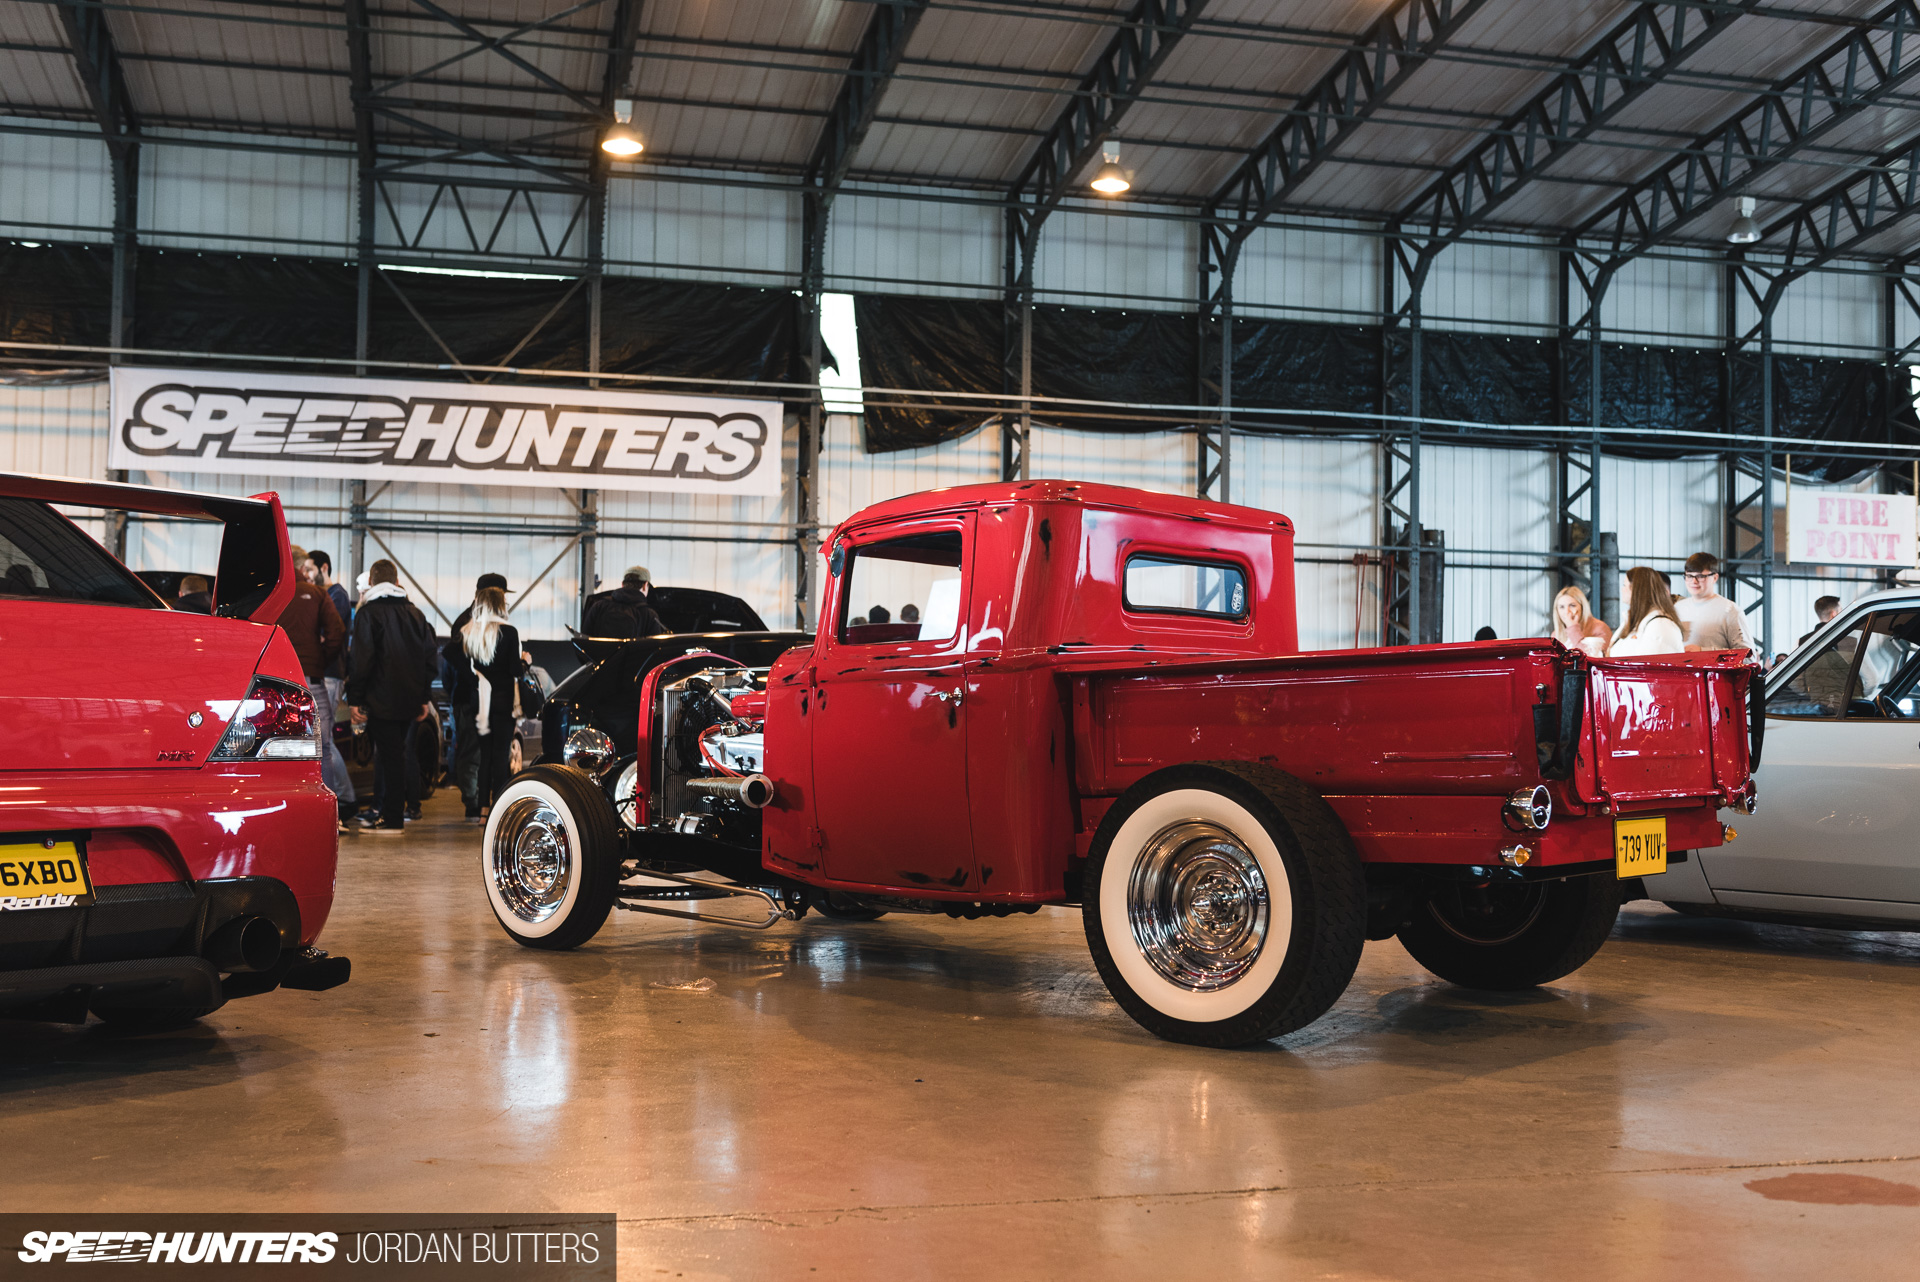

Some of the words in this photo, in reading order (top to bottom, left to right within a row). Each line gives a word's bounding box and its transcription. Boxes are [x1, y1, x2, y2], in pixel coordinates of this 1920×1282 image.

[122, 383, 768, 482] SPEEDHUNTERS
[1817, 497, 1888, 527] FIRE
[1806, 529, 1900, 560] POINT
[156, 750, 196, 761] MR
[1622, 834, 1642, 863] 739
[1644, 832, 1662, 861] YUV
